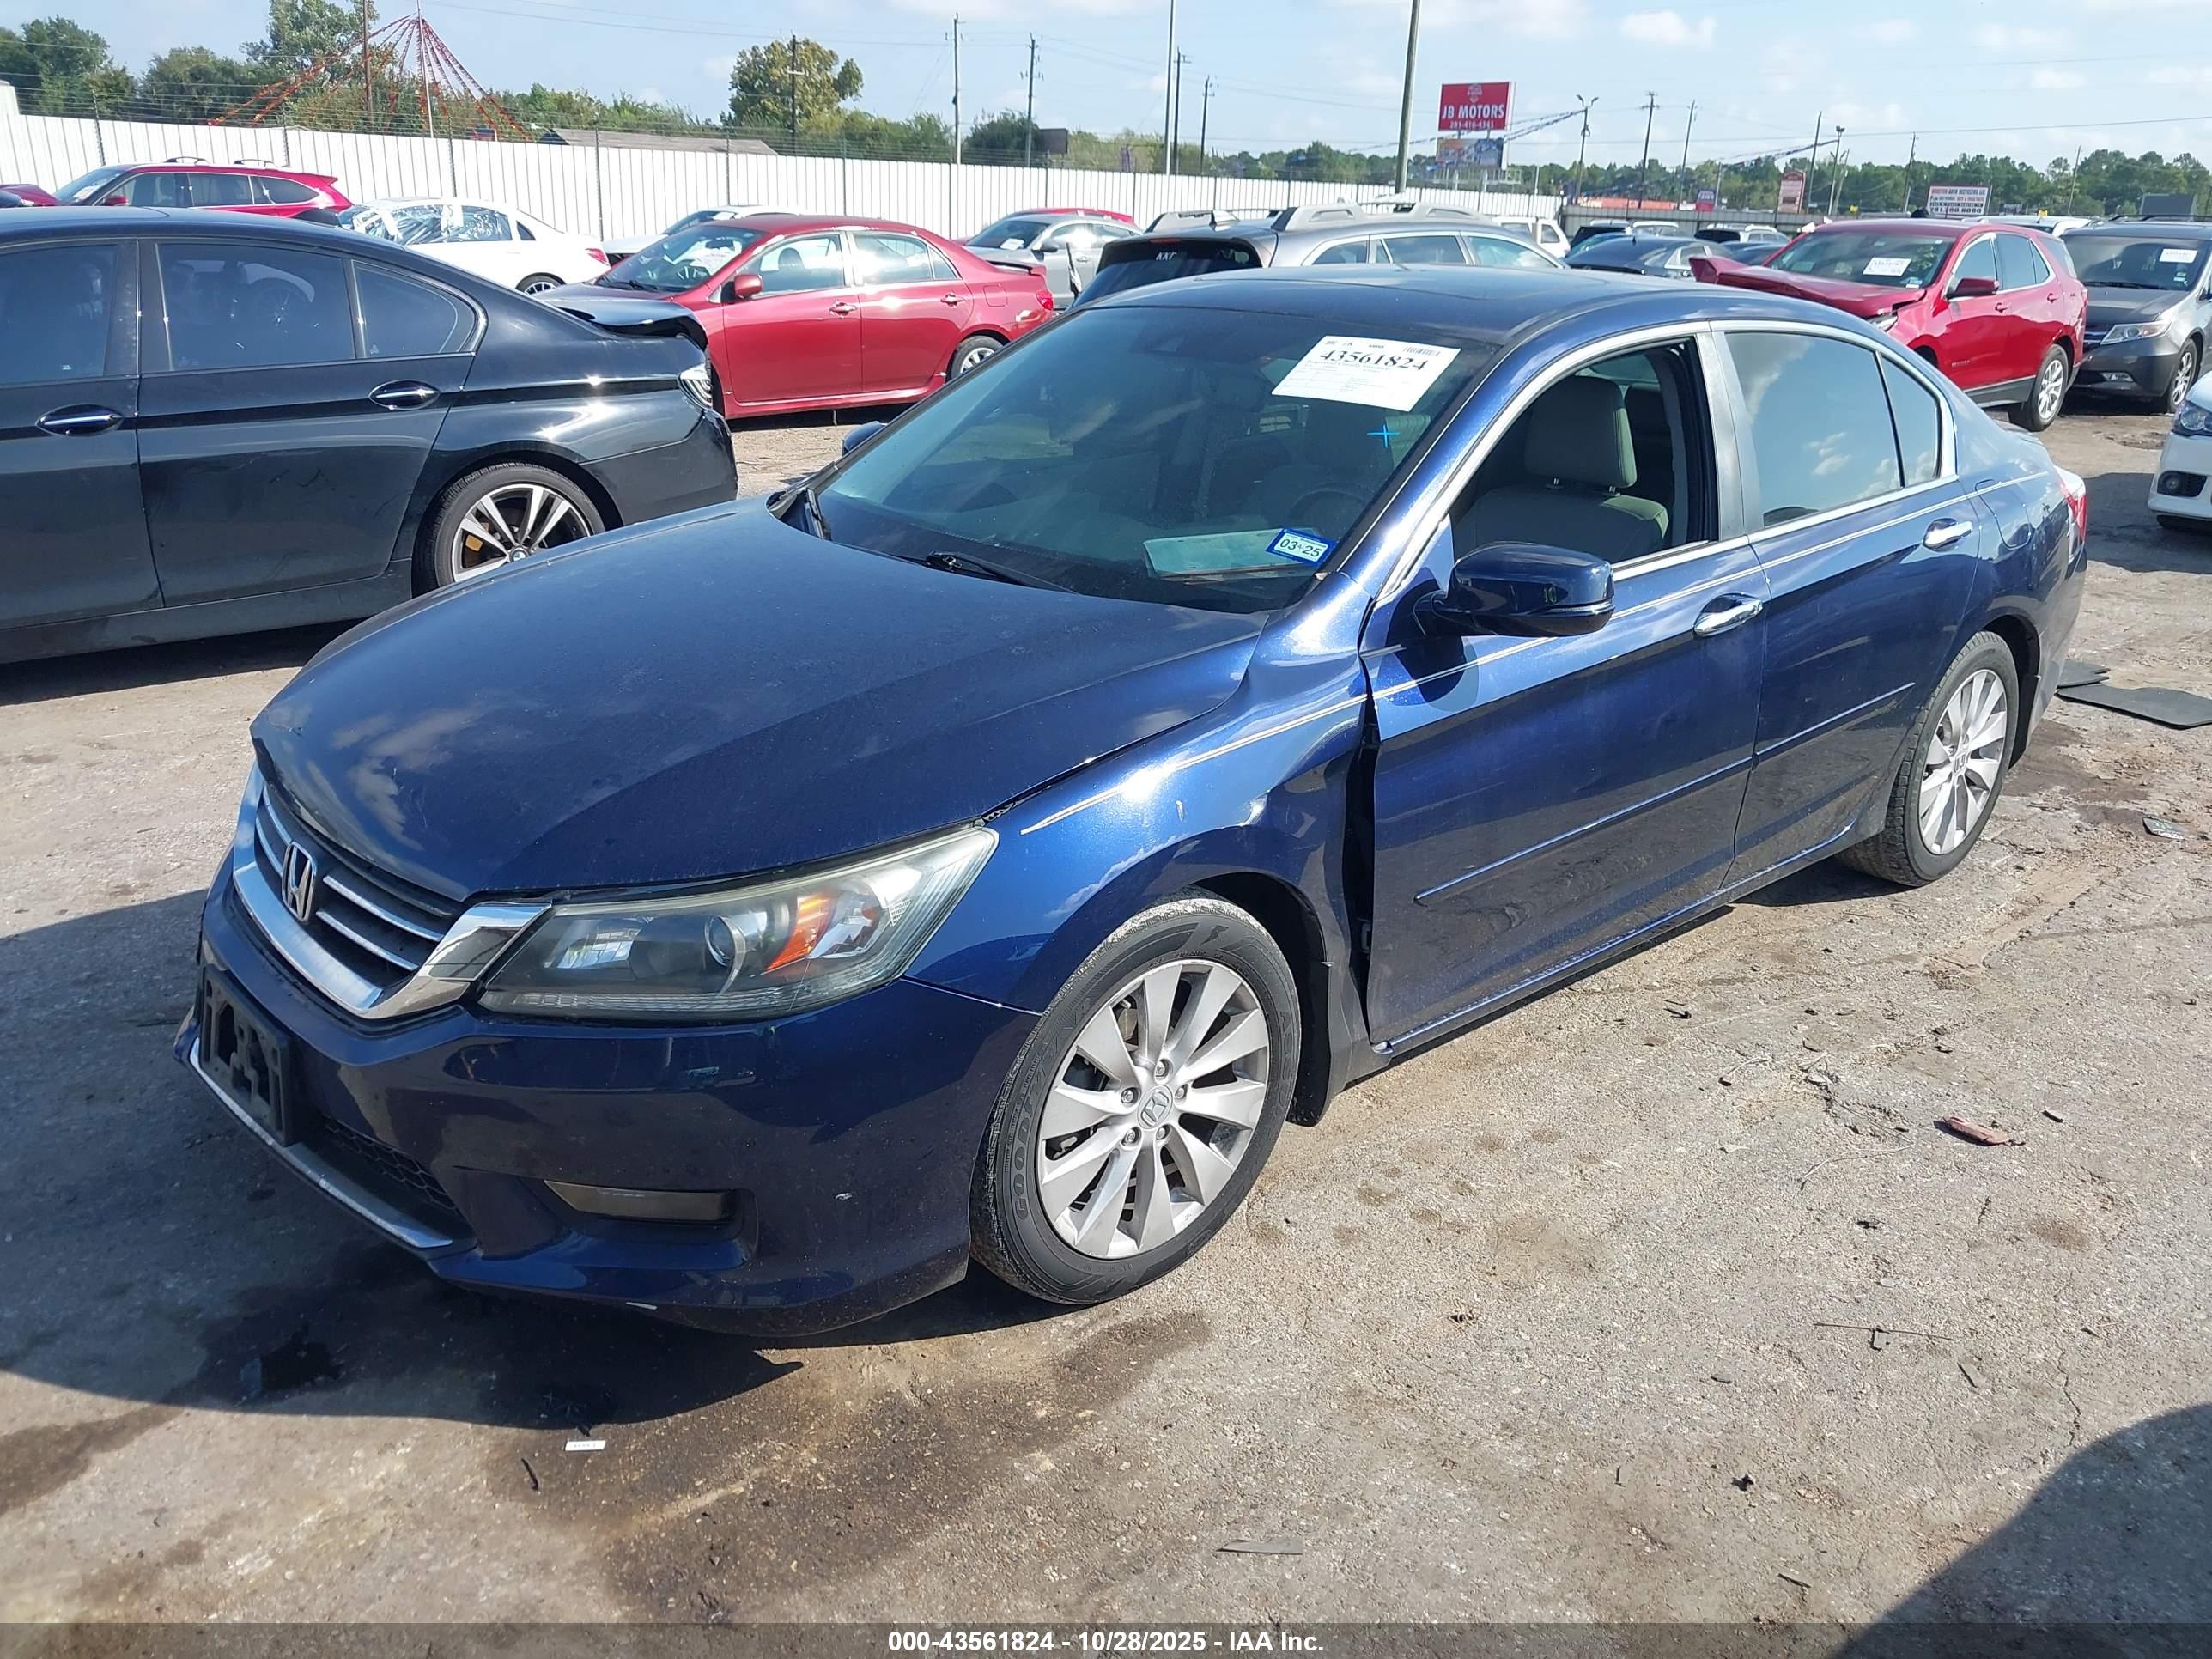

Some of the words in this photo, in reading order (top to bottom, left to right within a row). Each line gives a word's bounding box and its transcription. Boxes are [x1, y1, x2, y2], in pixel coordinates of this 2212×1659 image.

[1442, 104, 1455, 119] JB
[1457, 103, 1504, 119] MOTORS
[1320, 349, 1429, 371] 43561824
[1279, 538, 1298, 550] 03
[1302, 545, 1323, 557] 25
